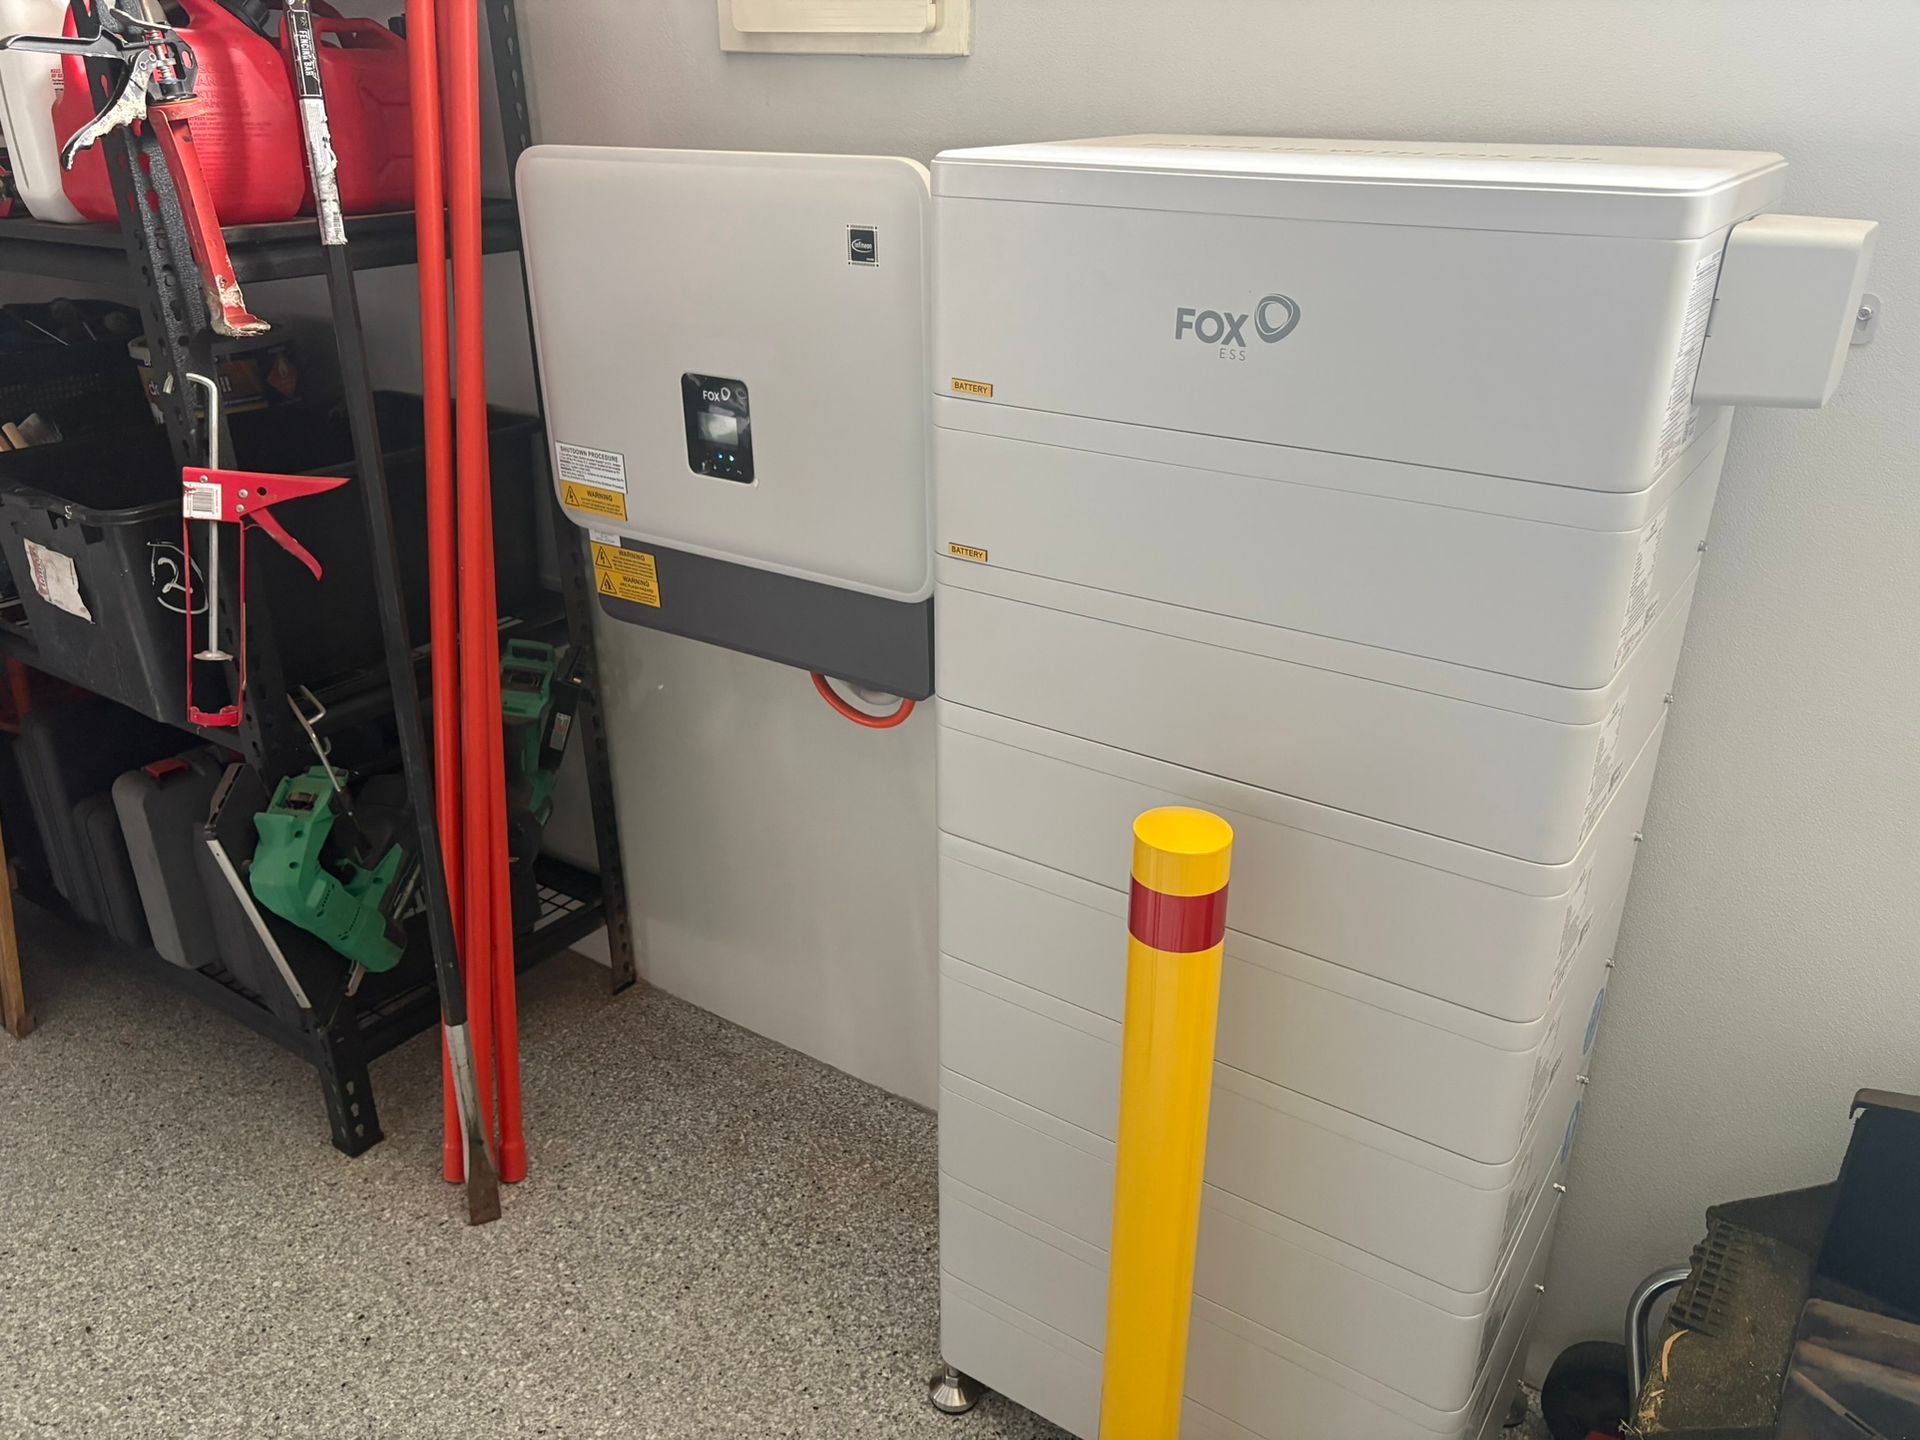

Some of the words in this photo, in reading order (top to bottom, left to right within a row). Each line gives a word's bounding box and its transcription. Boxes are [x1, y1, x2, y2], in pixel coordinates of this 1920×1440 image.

[1175, 307, 1249, 348] FOX
[1219, 348, 1246, 361] ESS
[954, 381, 988, 394] BATTERY
[702, 390, 720, 402] FOX
[560, 446, 587, 457] SHUTDOWN
[588, 451, 618, 463] PROCEDURE
[587, 490, 613, 502] WARNING
[618, 550, 645, 561] WARNING
[951, 546, 983, 559] BATTERY
[623, 575, 650, 588] WARNING
